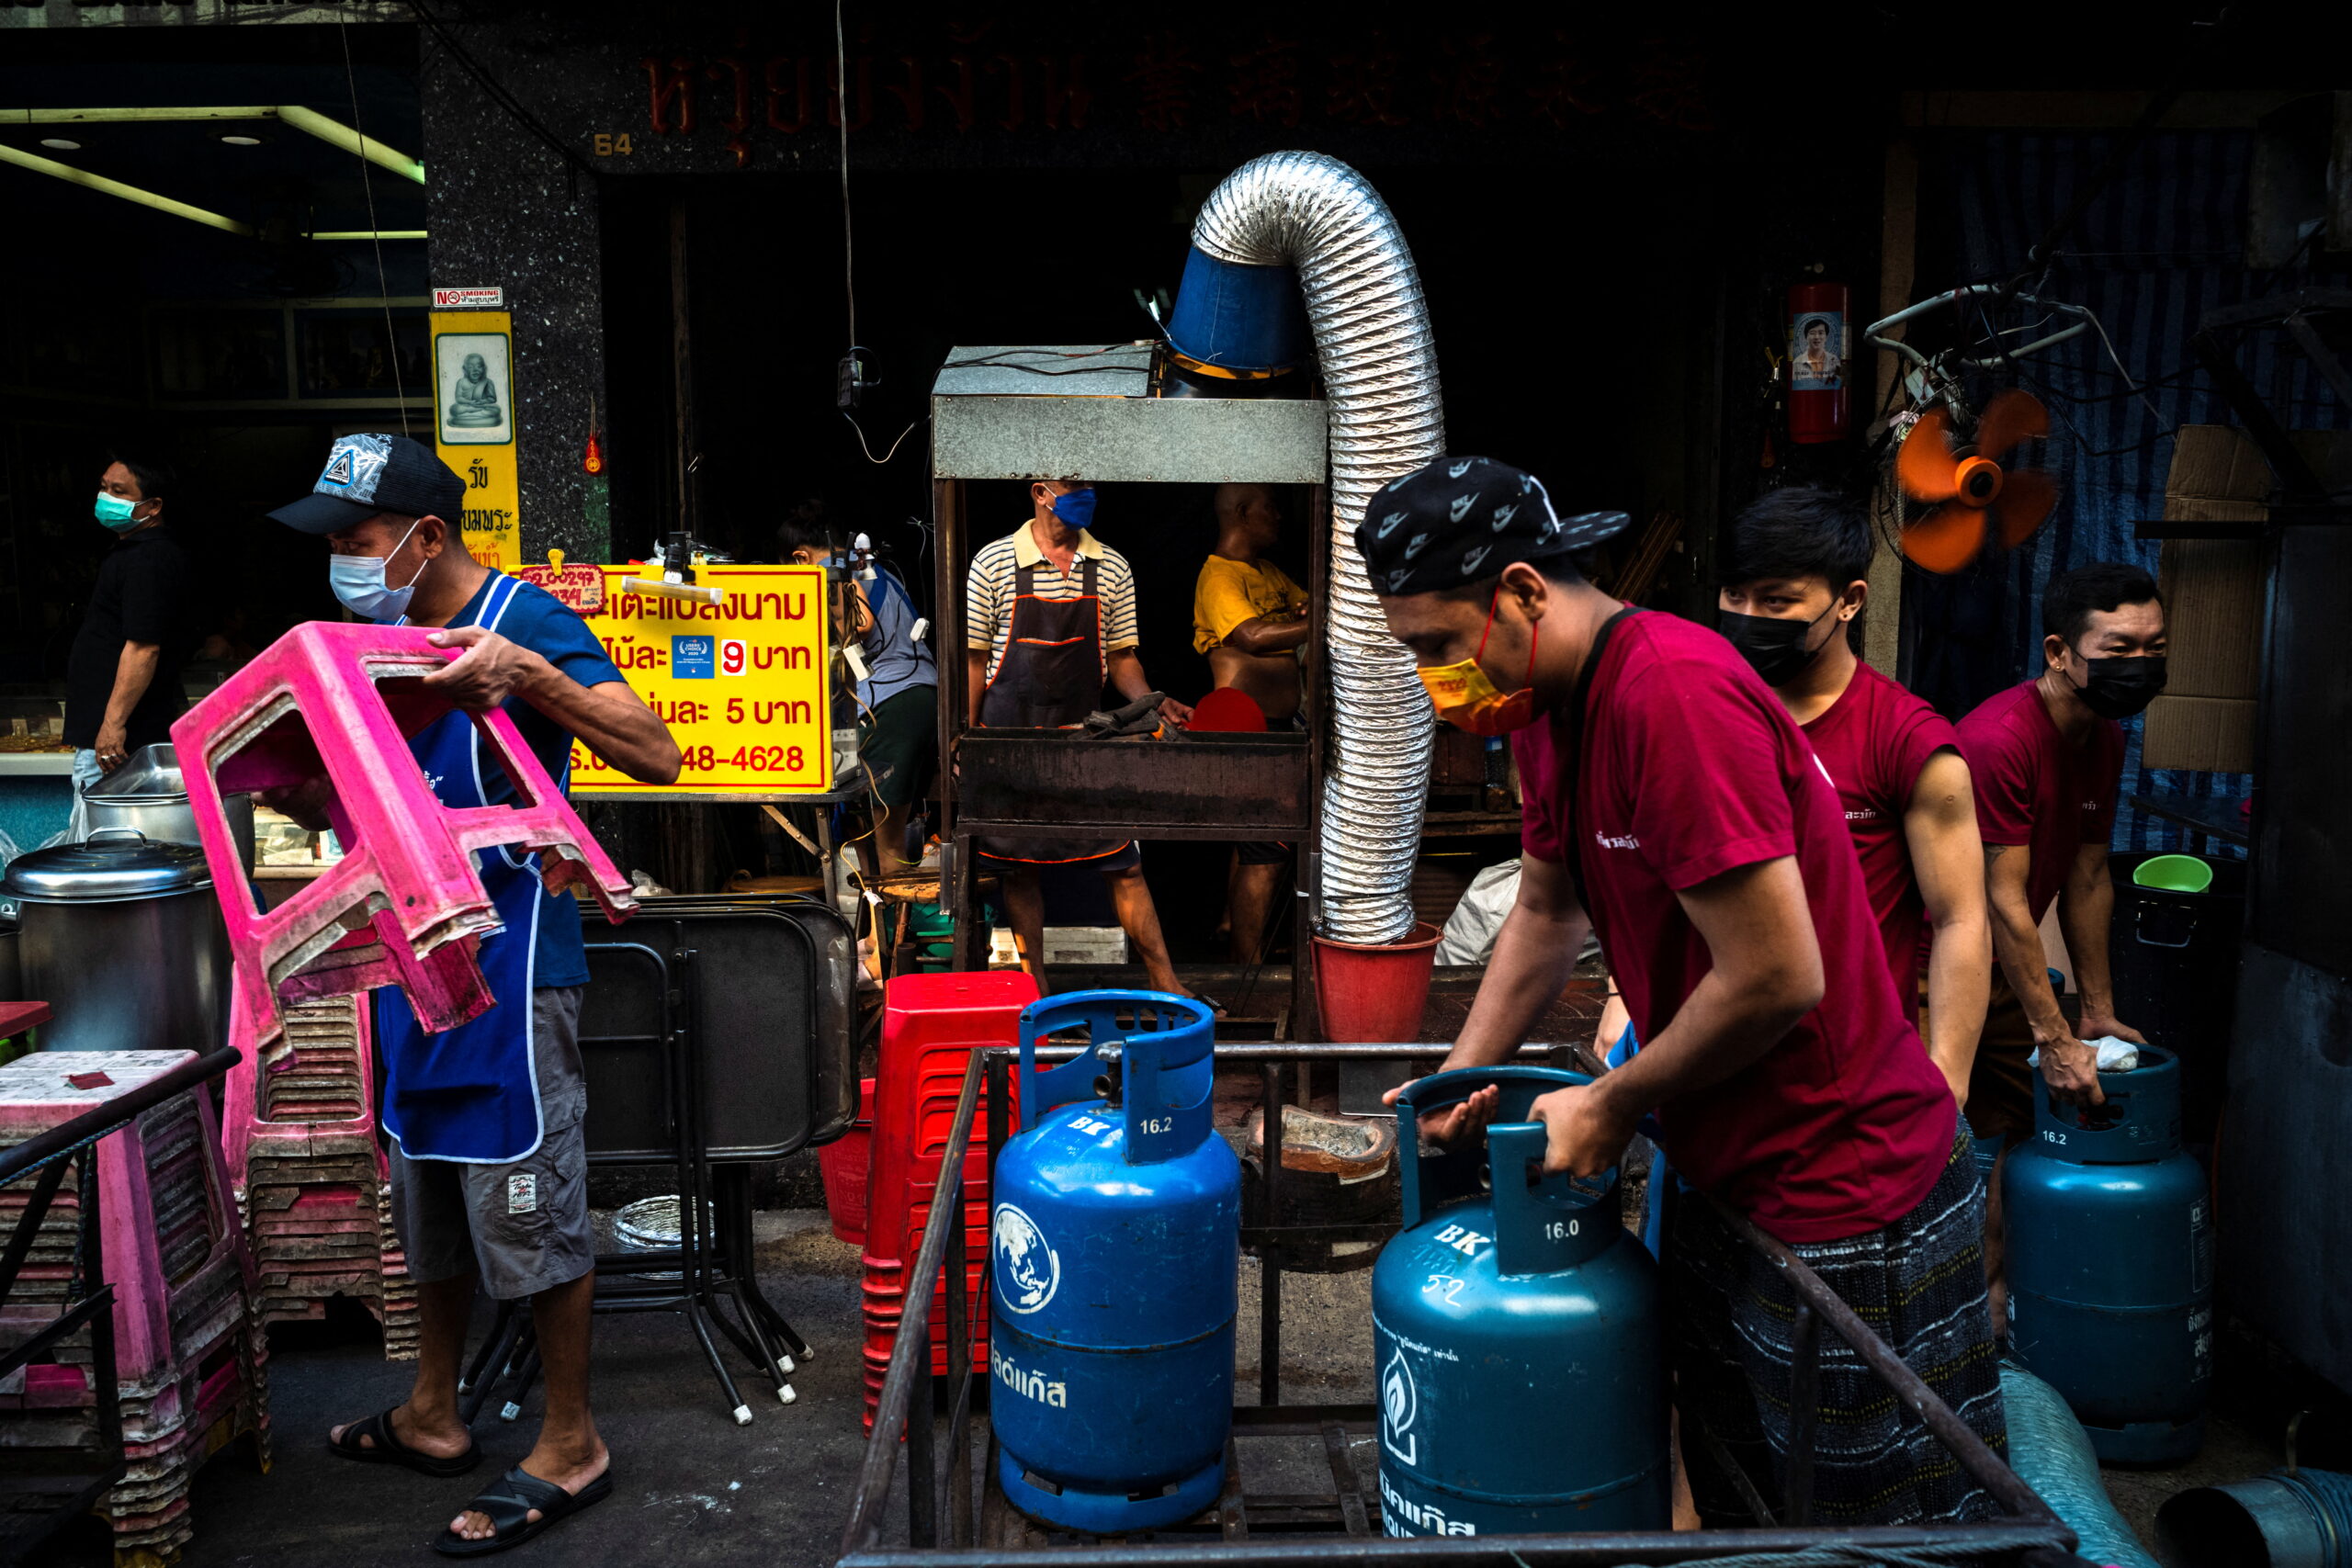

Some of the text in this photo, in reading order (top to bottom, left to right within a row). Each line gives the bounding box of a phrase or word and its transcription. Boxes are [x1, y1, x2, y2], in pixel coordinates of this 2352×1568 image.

[594, 133, 633, 157] 64
[469, 458, 488, 489] รับ
[723, 641, 744, 673] 9
[754, 645, 811, 670] บาท
[726, 698, 745, 724] 5
[754, 700, 811, 724] บาท
[1067, 1117, 1111, 1135] BK
[1140, 1117, 1172, 1134] 16.2
[2042, 1130, 2067, 1145] 16.2
[1434, 1224, 1491, 1256] BK
[1545, 1219, 1579, 1240] 16.0
[1421, 1274, 1465, 1307] 52
